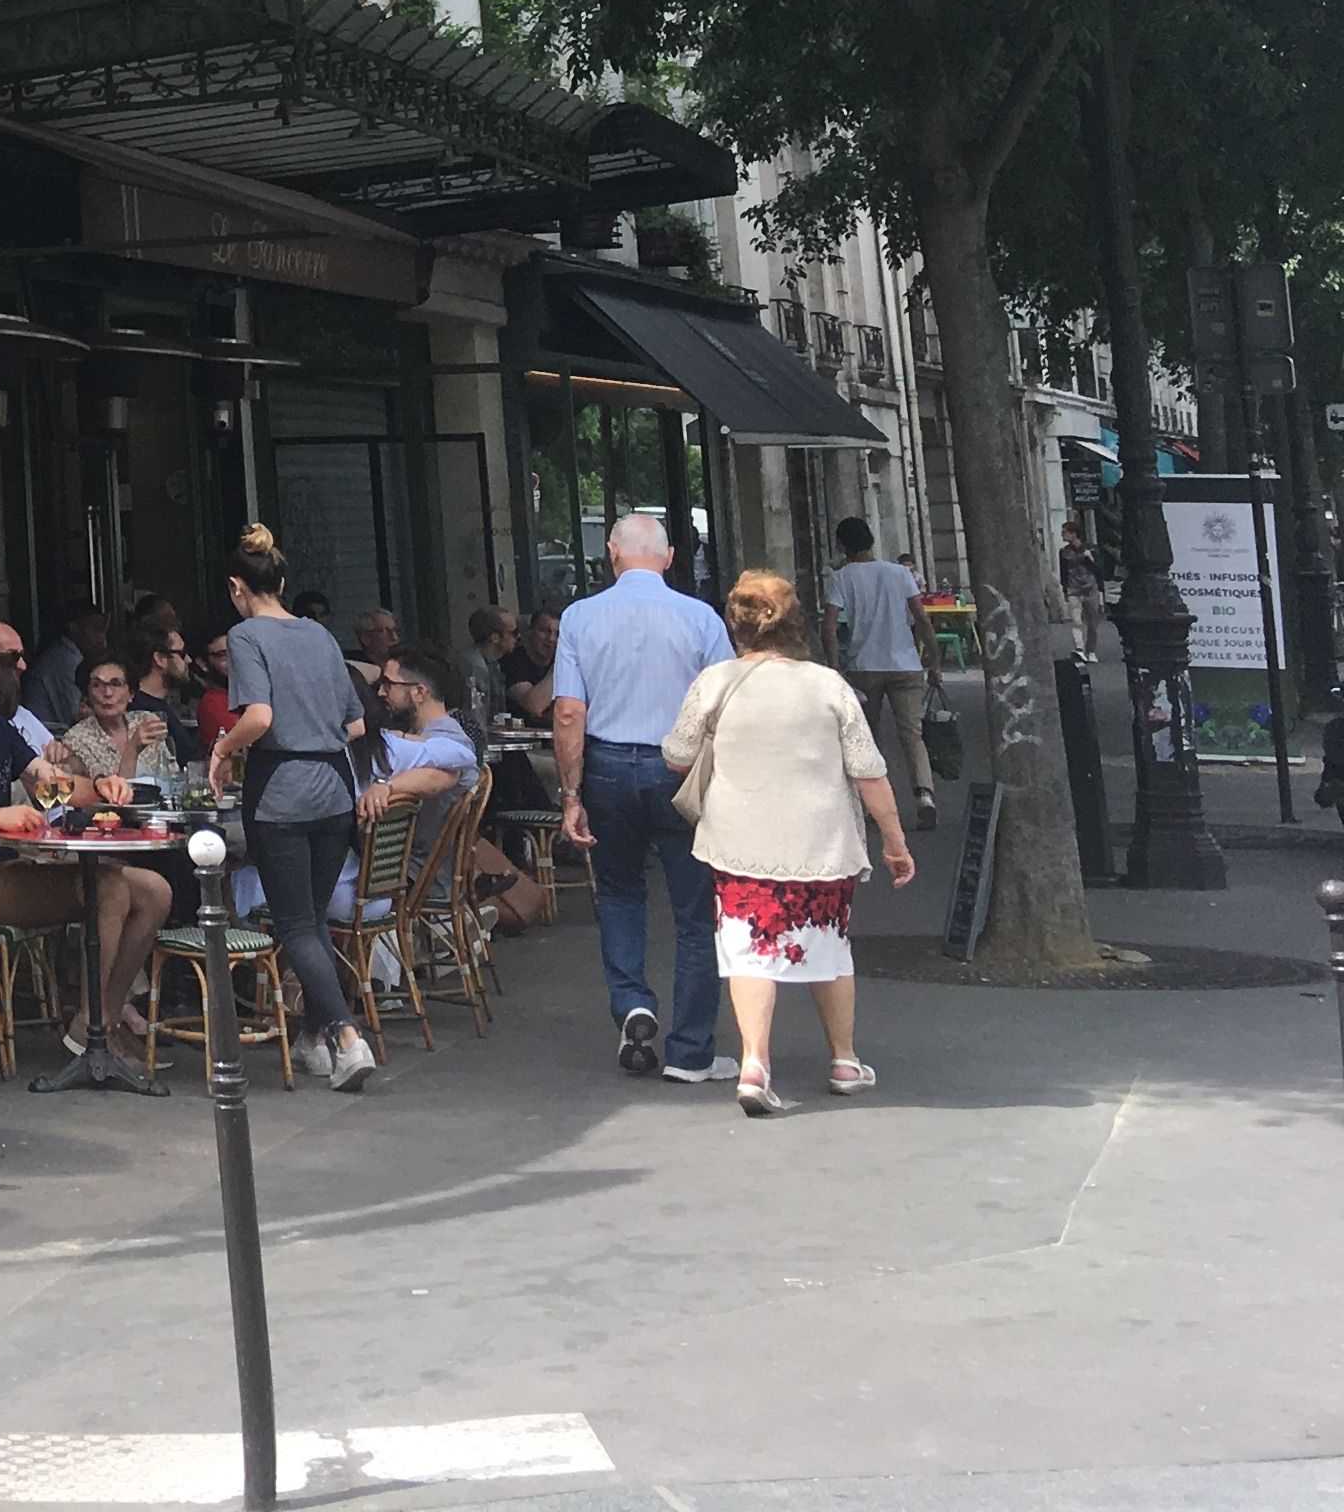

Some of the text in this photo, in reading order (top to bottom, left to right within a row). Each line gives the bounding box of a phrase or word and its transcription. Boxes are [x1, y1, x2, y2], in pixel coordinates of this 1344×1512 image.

[1209, 573, 1258, 582] INFUSIO
[1212, 605, 1236, 615] BIO
[1215, 625, 1261, 634] DÉGUST
[1190, 638, 1220, 647] AQUE
[1236, 653, 1264, 662] SAVE
